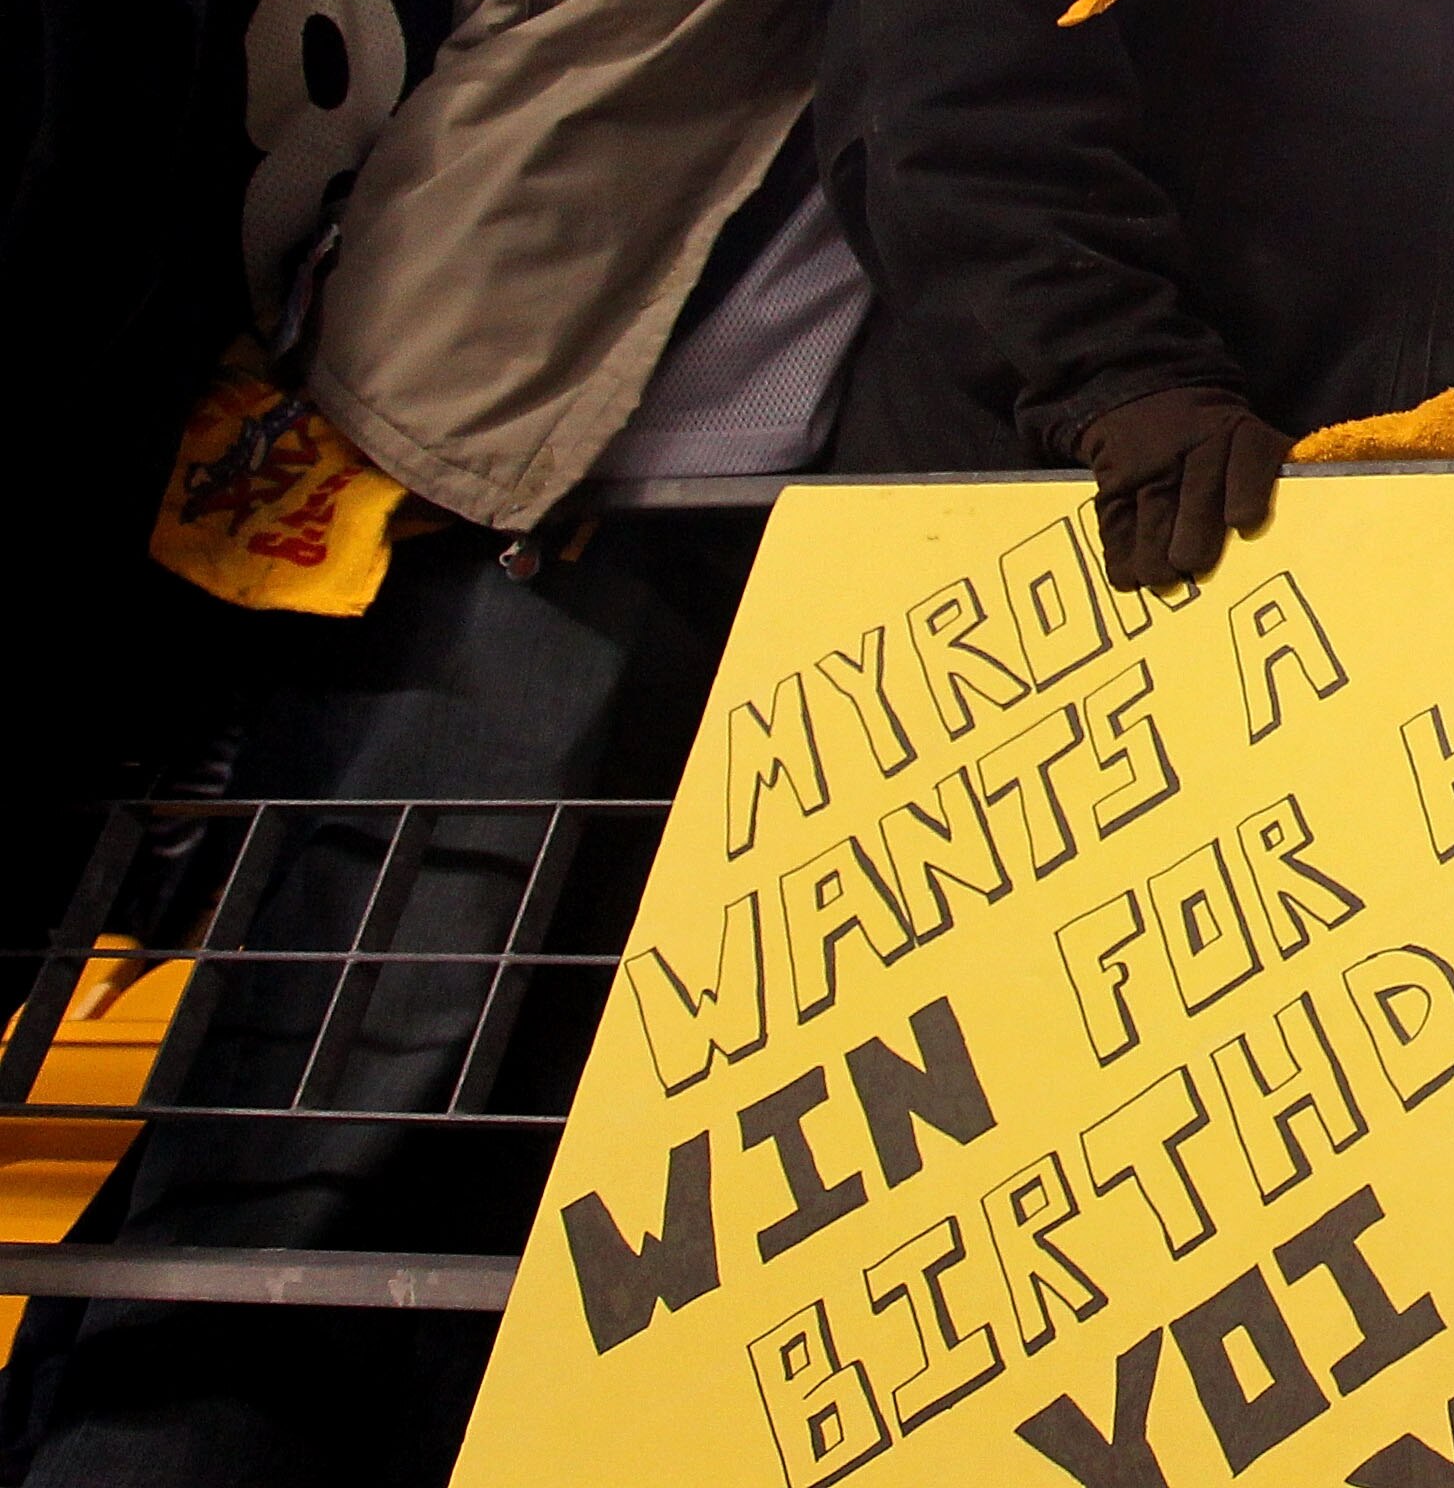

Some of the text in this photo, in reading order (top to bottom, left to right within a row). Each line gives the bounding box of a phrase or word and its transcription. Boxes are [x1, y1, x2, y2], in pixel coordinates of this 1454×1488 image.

[560, 996, 998, 1357] WIN
[1054, 793, 1367, 1068] FOR
[624, 570, 1349, 1098] WANTS A
[1014, 1183, 1448, 1488] YOI
